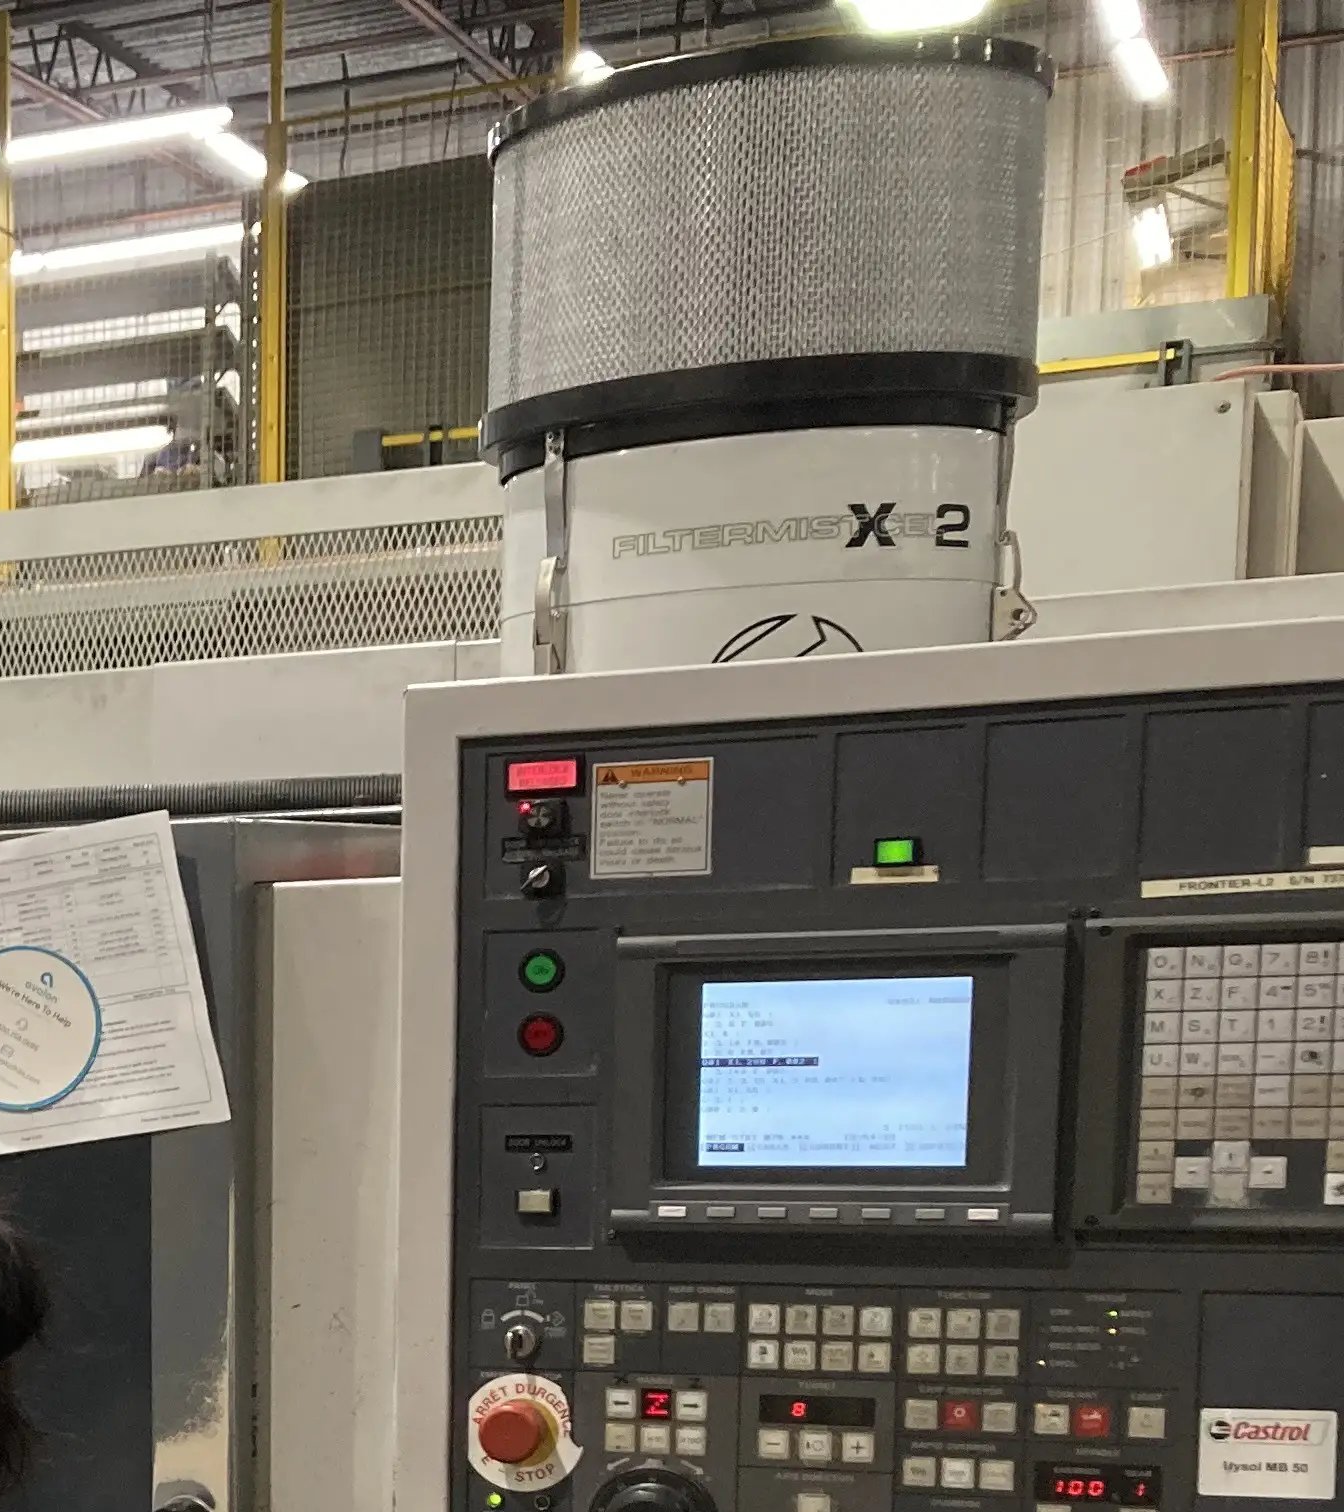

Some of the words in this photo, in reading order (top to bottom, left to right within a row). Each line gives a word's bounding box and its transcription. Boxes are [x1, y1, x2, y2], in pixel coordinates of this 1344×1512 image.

[935, 502, 970, 549] 2
[631, 765, 693, 778] WARNING
[21, 992, 41, 1010] Here
[42, 1004, 52, 1016] To
[52, 1010, 72, 1028] Help
[791, 1401, 807, 1418] 8
[1233, 1421, 1311, 1441] Castrol
[515, 1463, 555, 1483] STOP
[1265, 1462, 1288, 1472] MB
[1292, 1463, 1309, 1473] 50
[1054, 1480, 1105, 1497] 100
